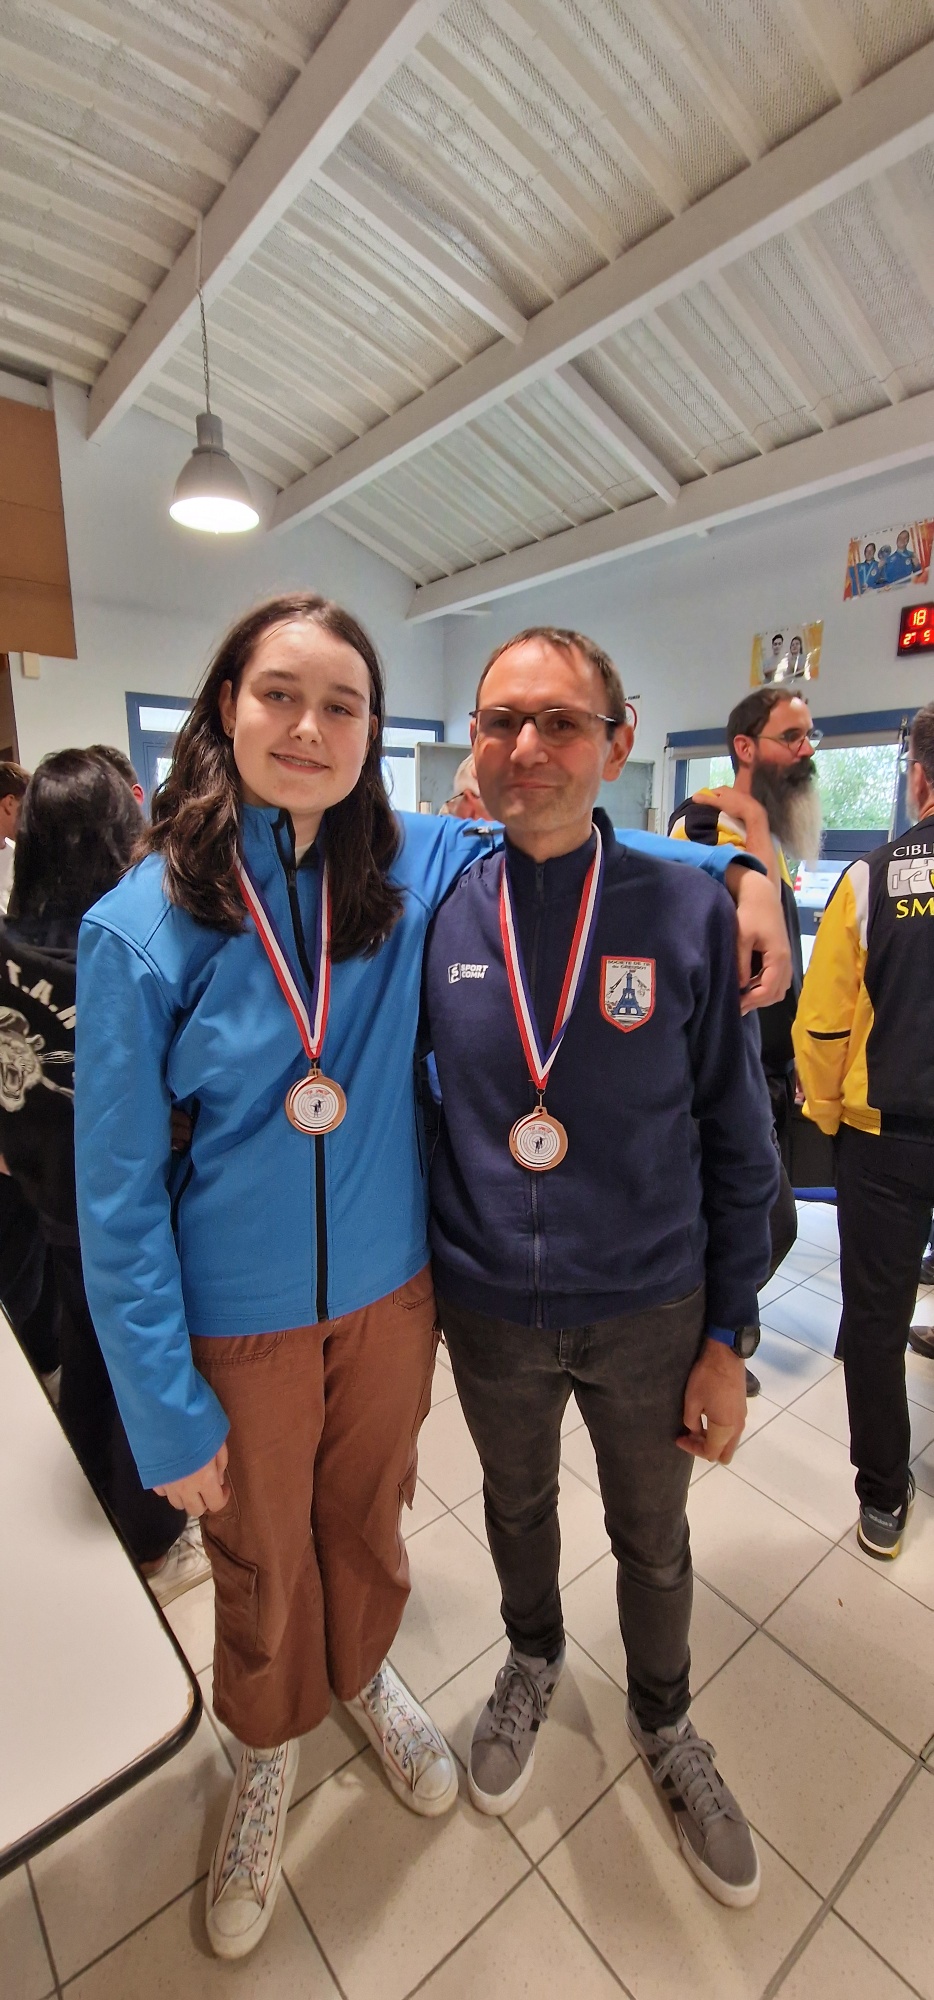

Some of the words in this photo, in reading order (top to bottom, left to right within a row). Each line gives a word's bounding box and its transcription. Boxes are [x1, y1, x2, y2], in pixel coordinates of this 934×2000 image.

[913, 609, 926, 625] 18
[460, 964, 488, 972] SPORT
[461, 971, 485, 979] COMM
